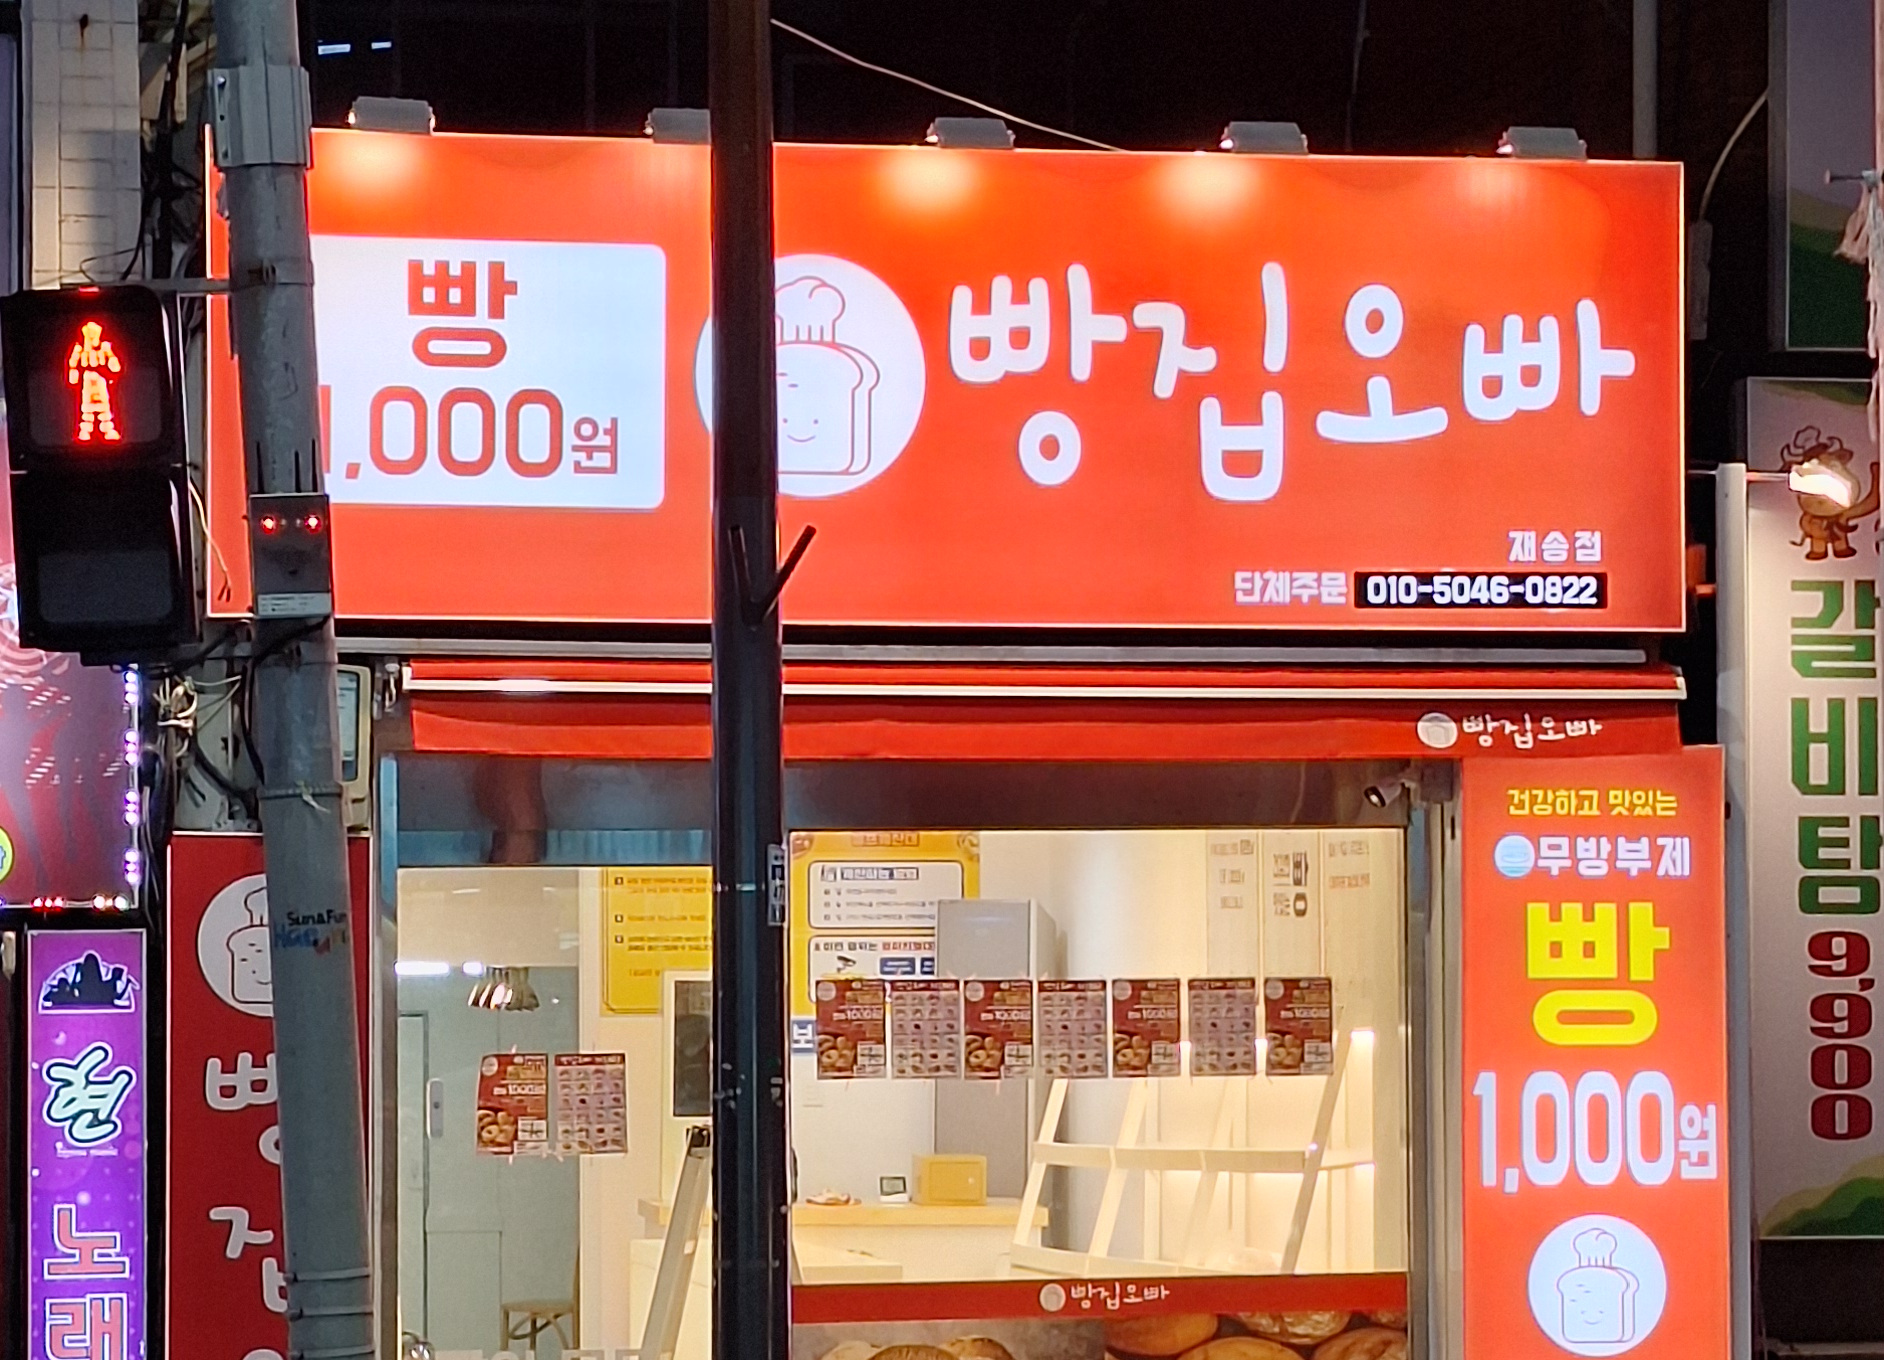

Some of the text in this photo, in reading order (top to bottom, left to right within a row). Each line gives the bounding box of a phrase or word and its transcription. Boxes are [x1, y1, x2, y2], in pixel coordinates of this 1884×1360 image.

[407, 259, 518, 368] 빵
[948, 261, 1637, 502] 빵집오빠
[1507, 530, 1602, 563] 재송점
[1233, 571, 1599, 606] 단체주문 010-5046-0822
[1461, 713, 1603, 749] 빵집오빠
[1790, 579, 1883, 915] 갈비탕
[1507, 788, 1679, 817] 건강하고 맛있는
[1536, 835, 1692, 878] 무방부제
[1526, 901, 1671, 1046] 빵
[1807, 930, 1876, 1141] 9,900
[1472, 1070, 1719, 1195] 1,000원
[1070, 1281, 1171, 1311] 빵집오빠
